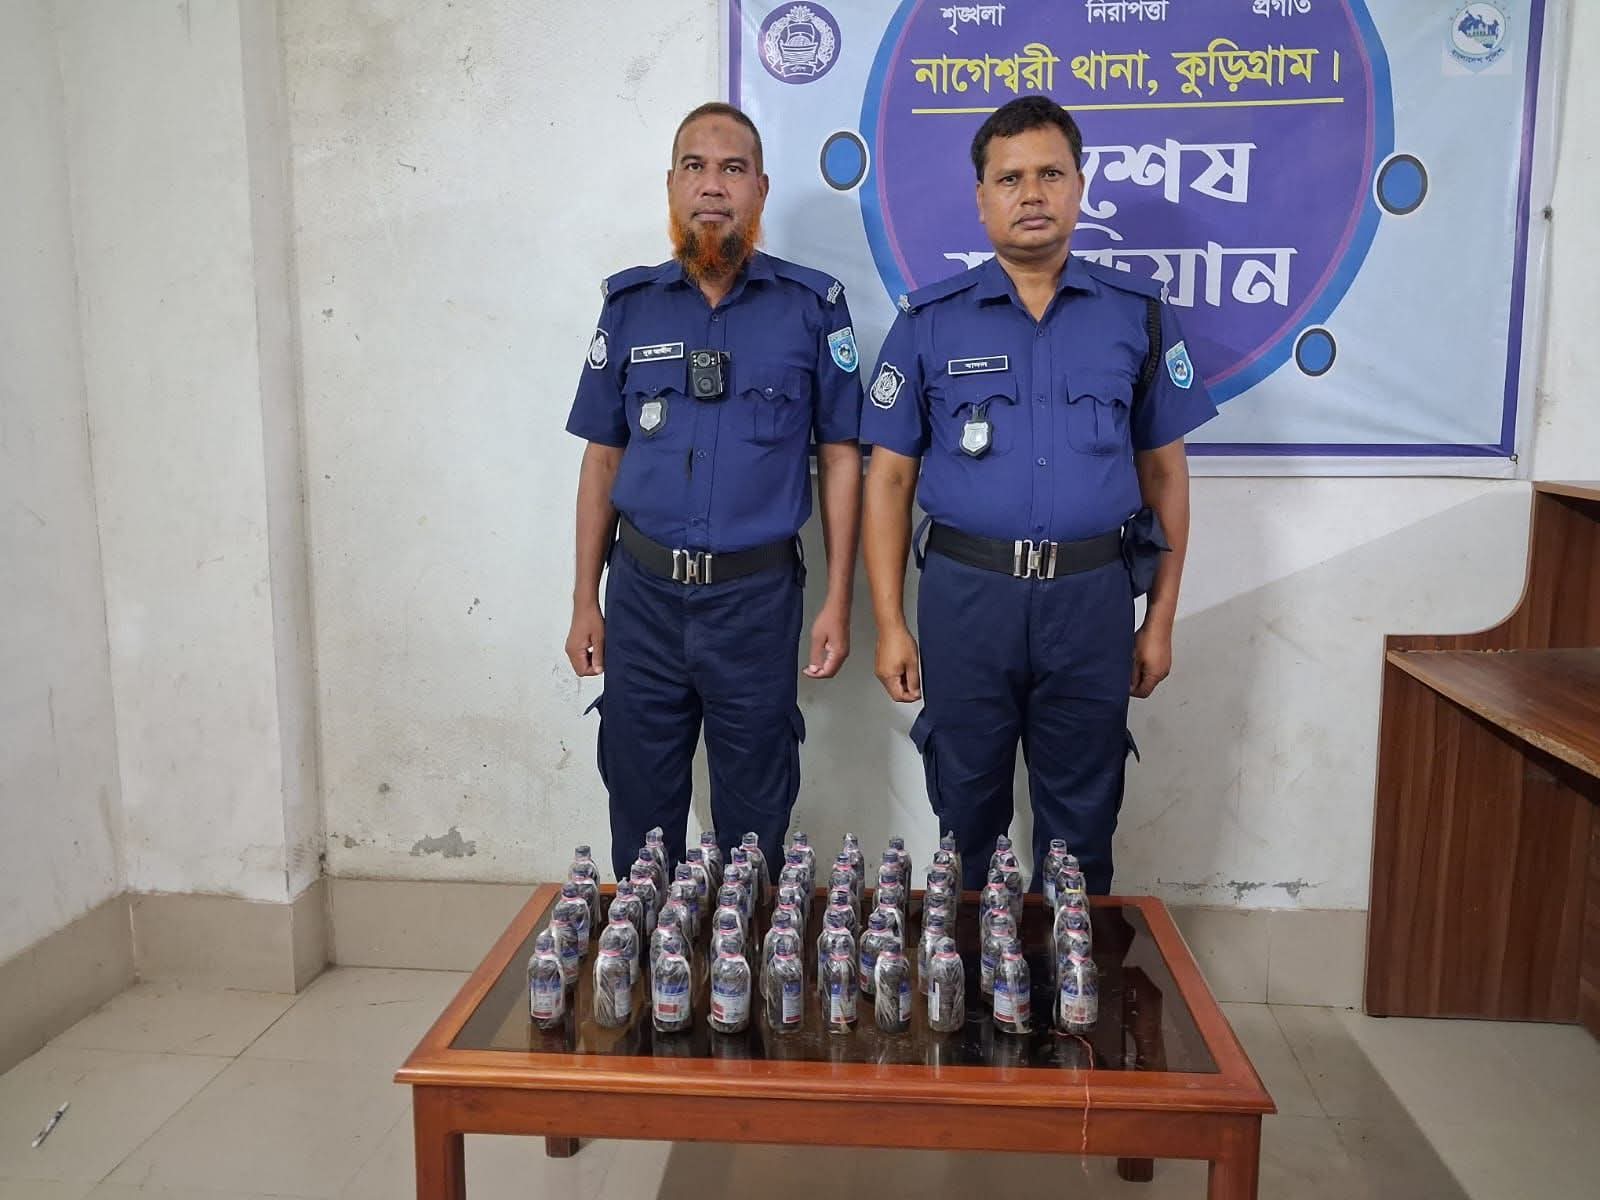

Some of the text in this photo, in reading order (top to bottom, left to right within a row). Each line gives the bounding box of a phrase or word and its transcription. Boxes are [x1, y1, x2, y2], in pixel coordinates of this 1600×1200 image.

[941, 4, 1005, 35] শৃঙ্খলা
[1086, 0, 1169, 23] নিরাপত্তা
[912, 43, 1060, 93] নাগেশ্বরী
[1071, 50, 1159, 95] থানা,
[1172, 38, 1319, 97] কুড়িগ্রাম
